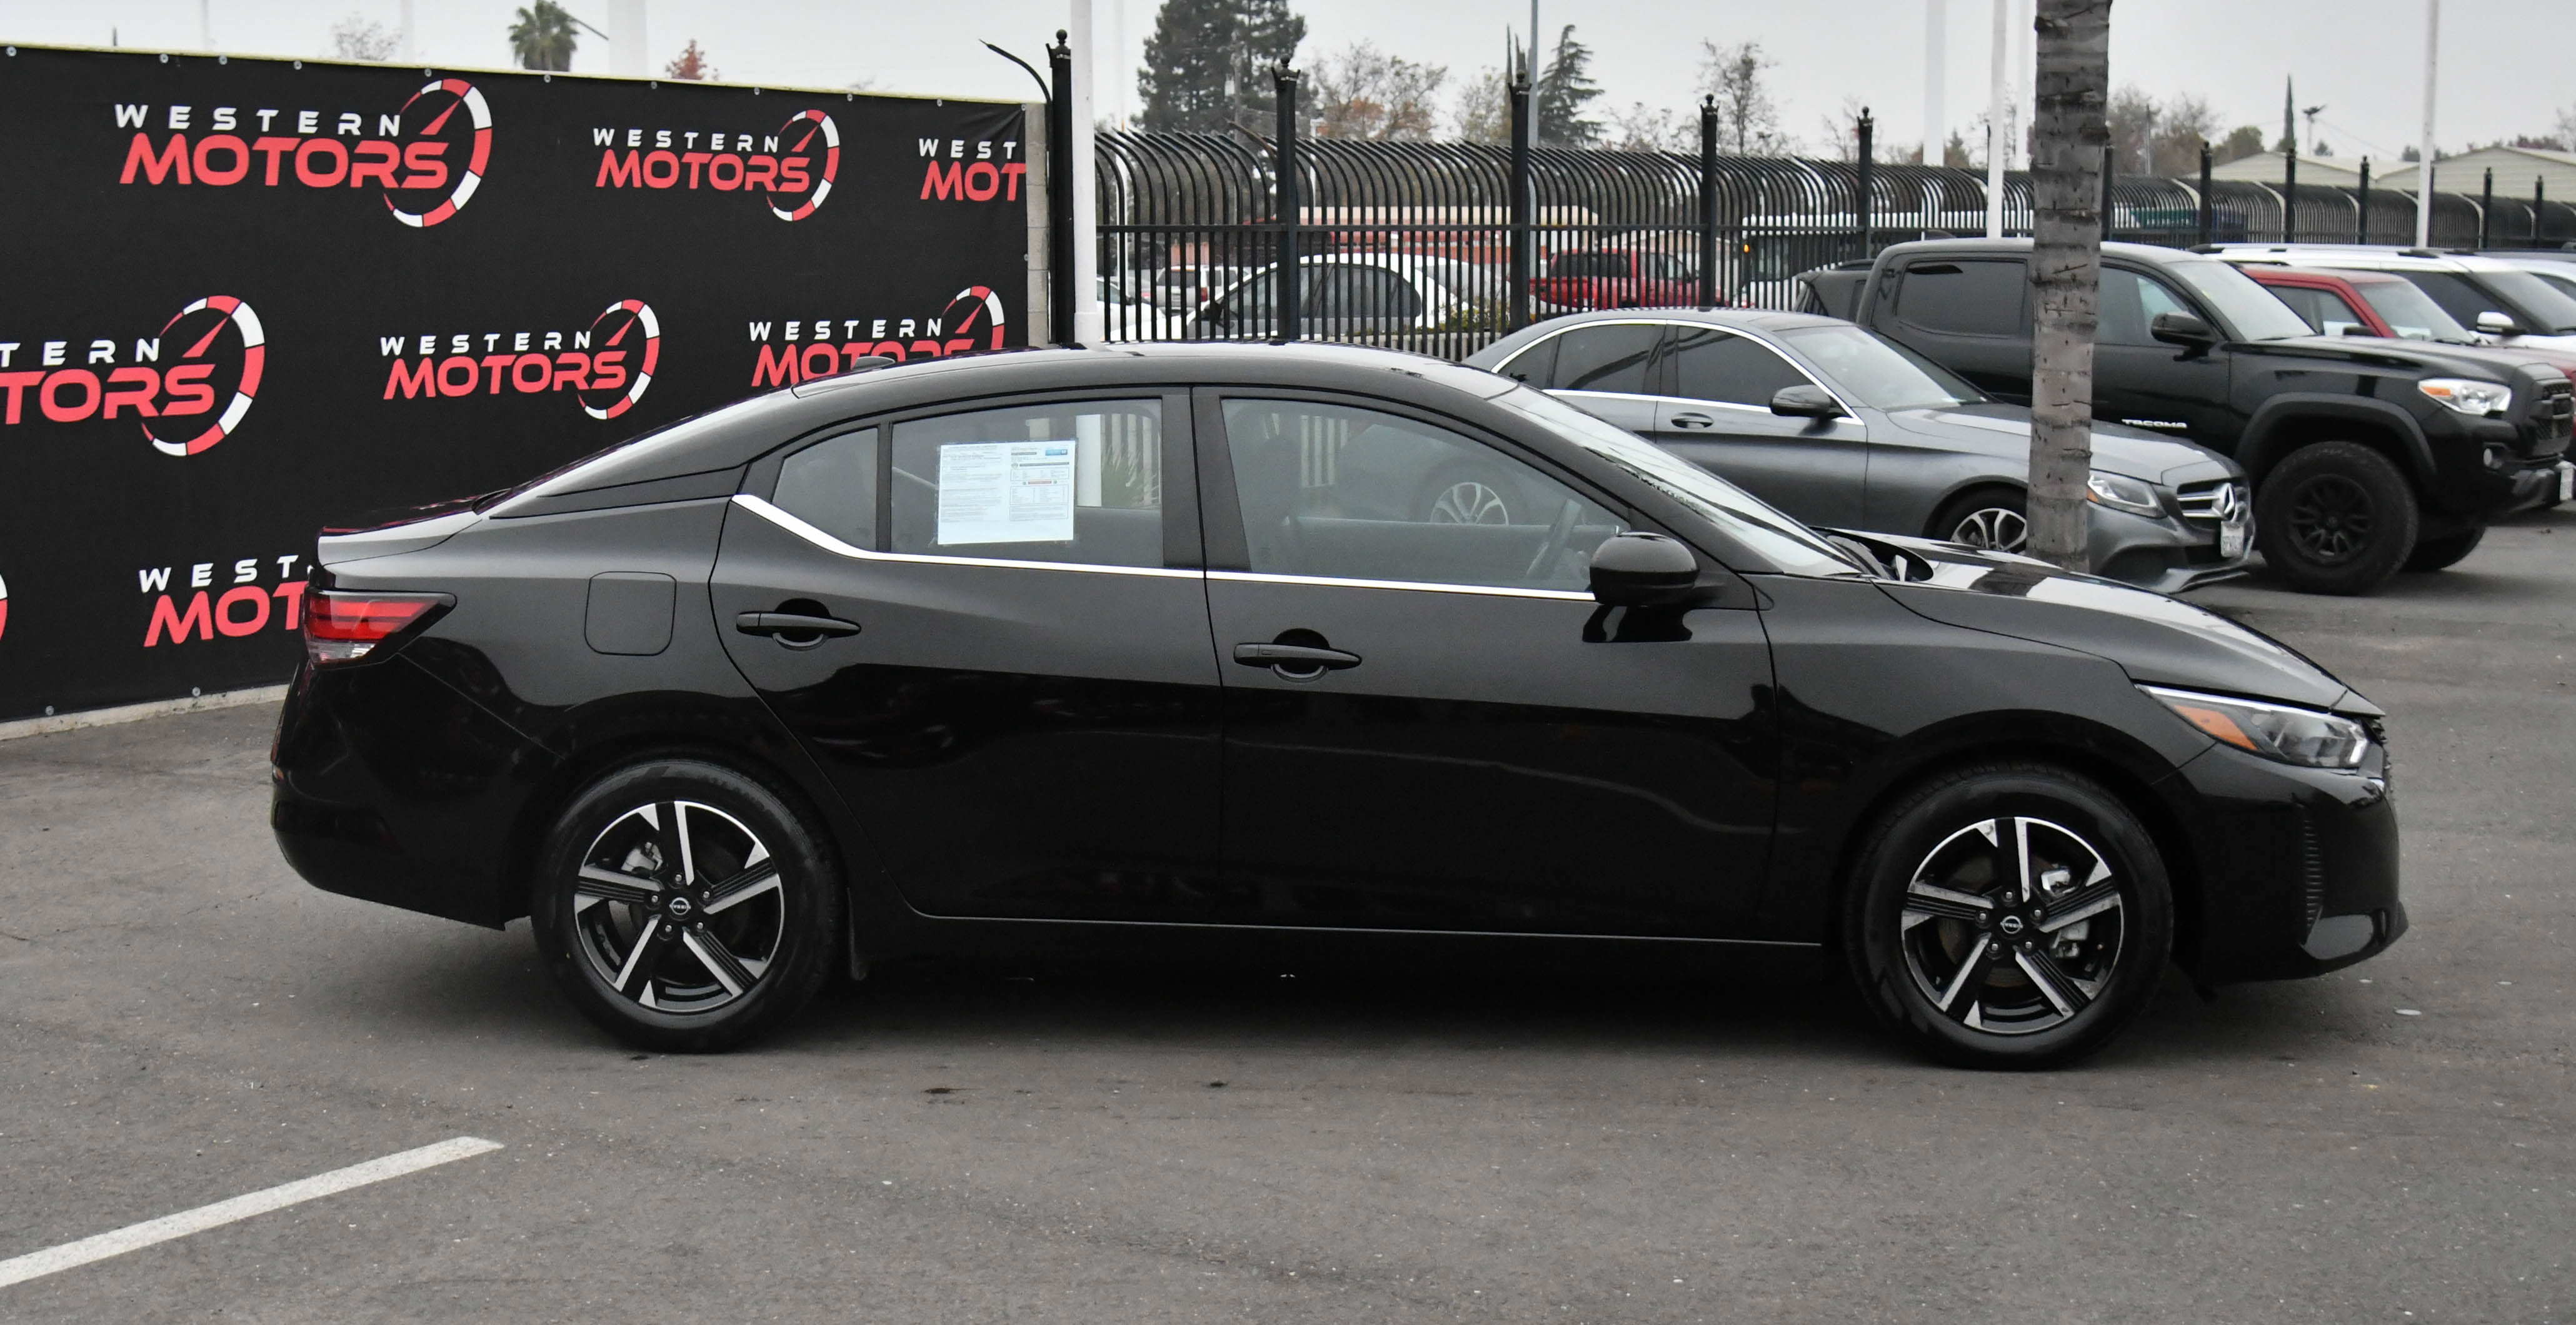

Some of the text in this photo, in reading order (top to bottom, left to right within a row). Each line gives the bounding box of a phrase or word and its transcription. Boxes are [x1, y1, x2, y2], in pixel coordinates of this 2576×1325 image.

[115, 104, 401, 137] WESTERN
[593, 128, 779, 153] WESTERN
[919, 138, 1017, 159] WEST
[119, 133, 449, 189] MOTORS
[596, 149, 810, 193] MOTORS
[920, 160, 1027, 201] MOT
[380, 331, 591, 356] WESTERN
[749, 318, 942, 341] WESTERN
[0, 338, 160, 368] TERN
[383, 350, 627, 400] MOTORS
[0, 364, 216, 425] TORS
[139, 555, 299, 593] WEST
[144, 581, 309, 647] MOT
